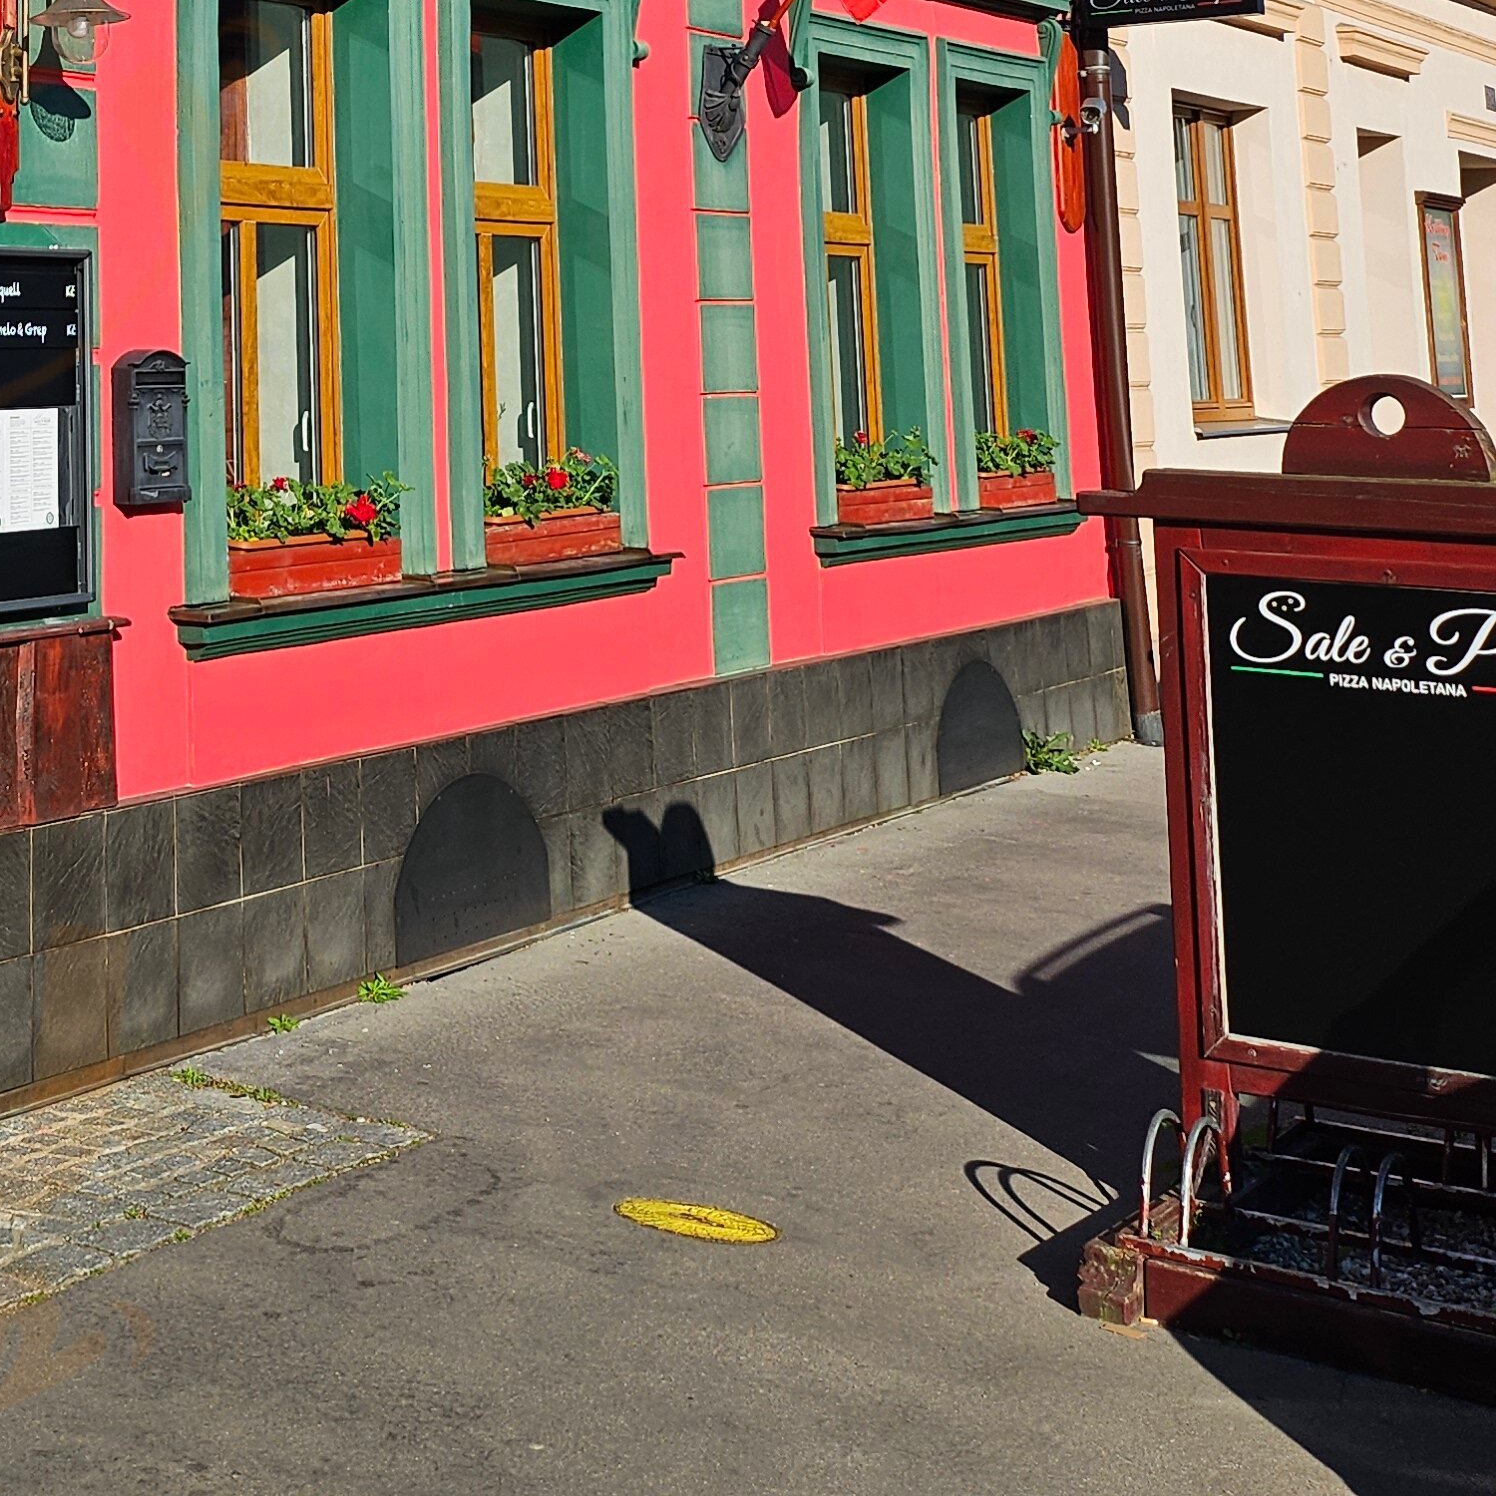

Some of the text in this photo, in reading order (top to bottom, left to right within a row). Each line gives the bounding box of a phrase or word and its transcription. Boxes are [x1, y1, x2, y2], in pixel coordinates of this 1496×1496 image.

[1134, 3, 1196, 15] PIZZA NAPOLETANA
[17, 321, 24, 337] &
[24, 321, 48, 344] Grep
[1229, 590, 1372, 665] Sale
[1383, 635, 1418, 668] &
[1329, 672, 1469, 698] PIZZA NAPOLETANA
